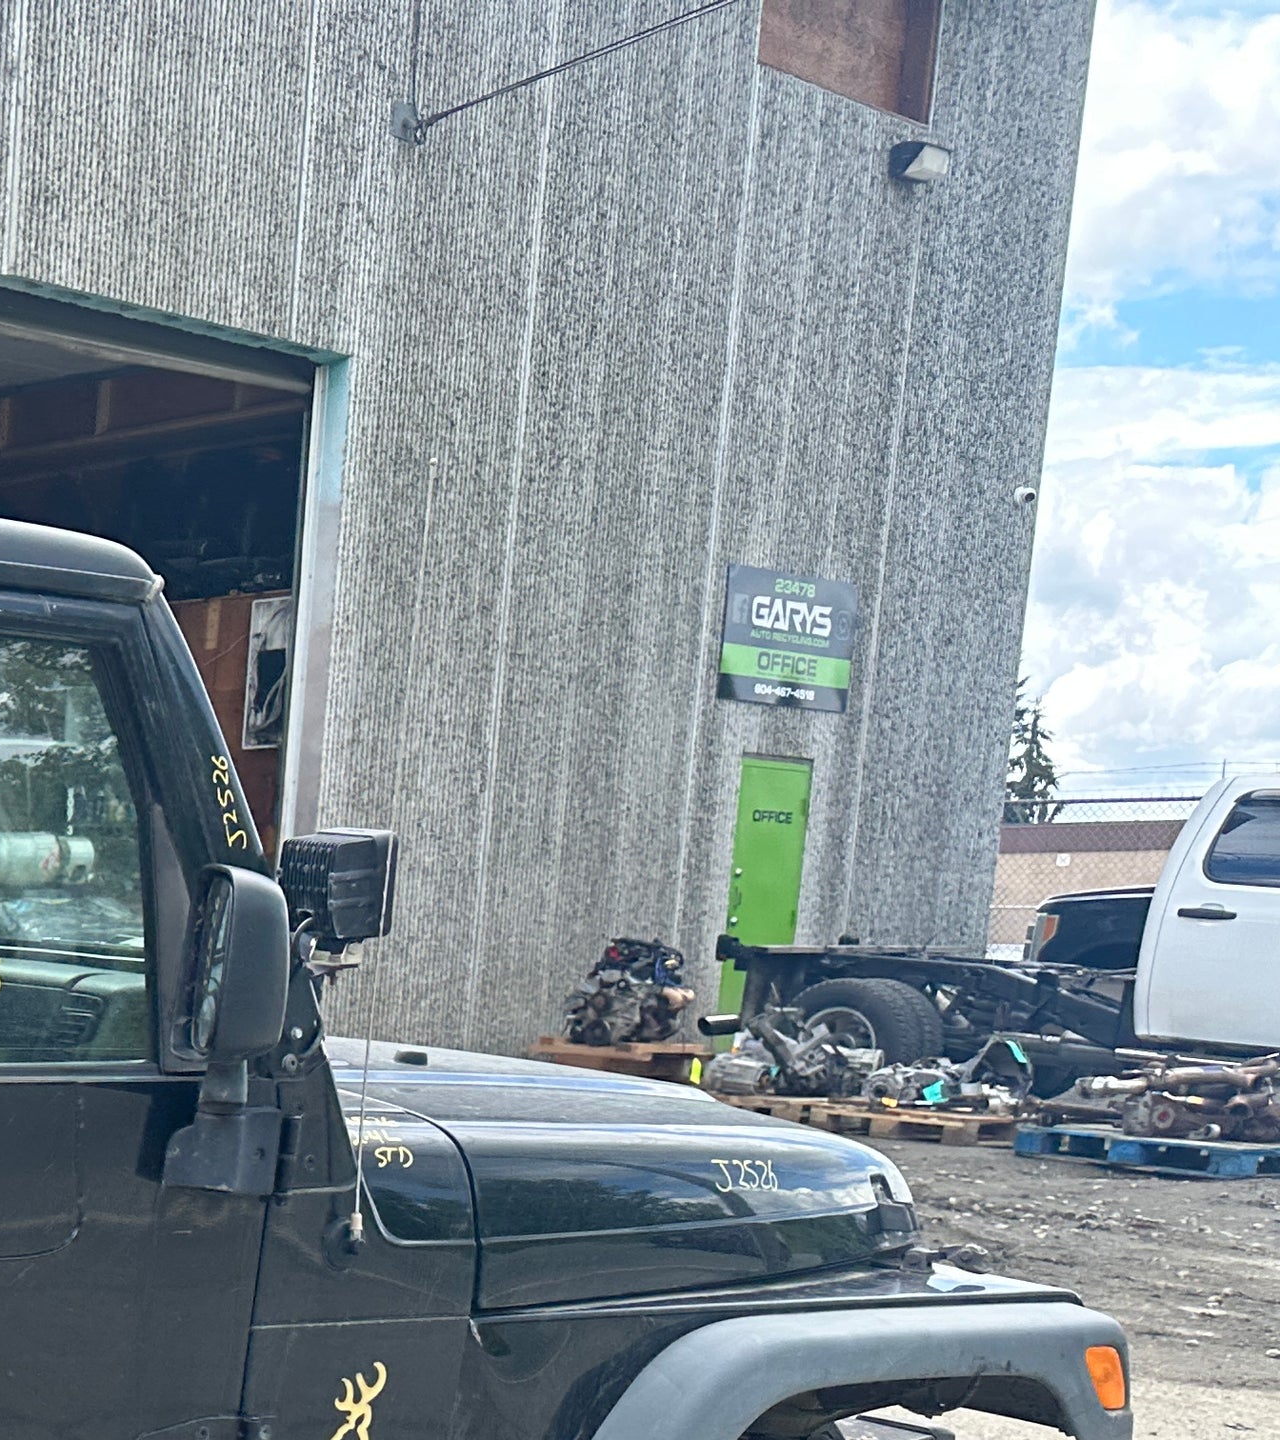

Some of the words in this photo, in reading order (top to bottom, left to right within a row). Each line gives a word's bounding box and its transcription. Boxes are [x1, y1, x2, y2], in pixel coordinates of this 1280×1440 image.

[774, 578, 816, 597] 23478
[752, 595, 832, 637] GARYS
[758, 652, 818, 677] OFFICE
[211, 754, 248, 850] J2526
[752, 809, 793, 825] OFFICE
[374, 1145, 414, 1168] STD
[710, 1158, 778, 1193] J2526
